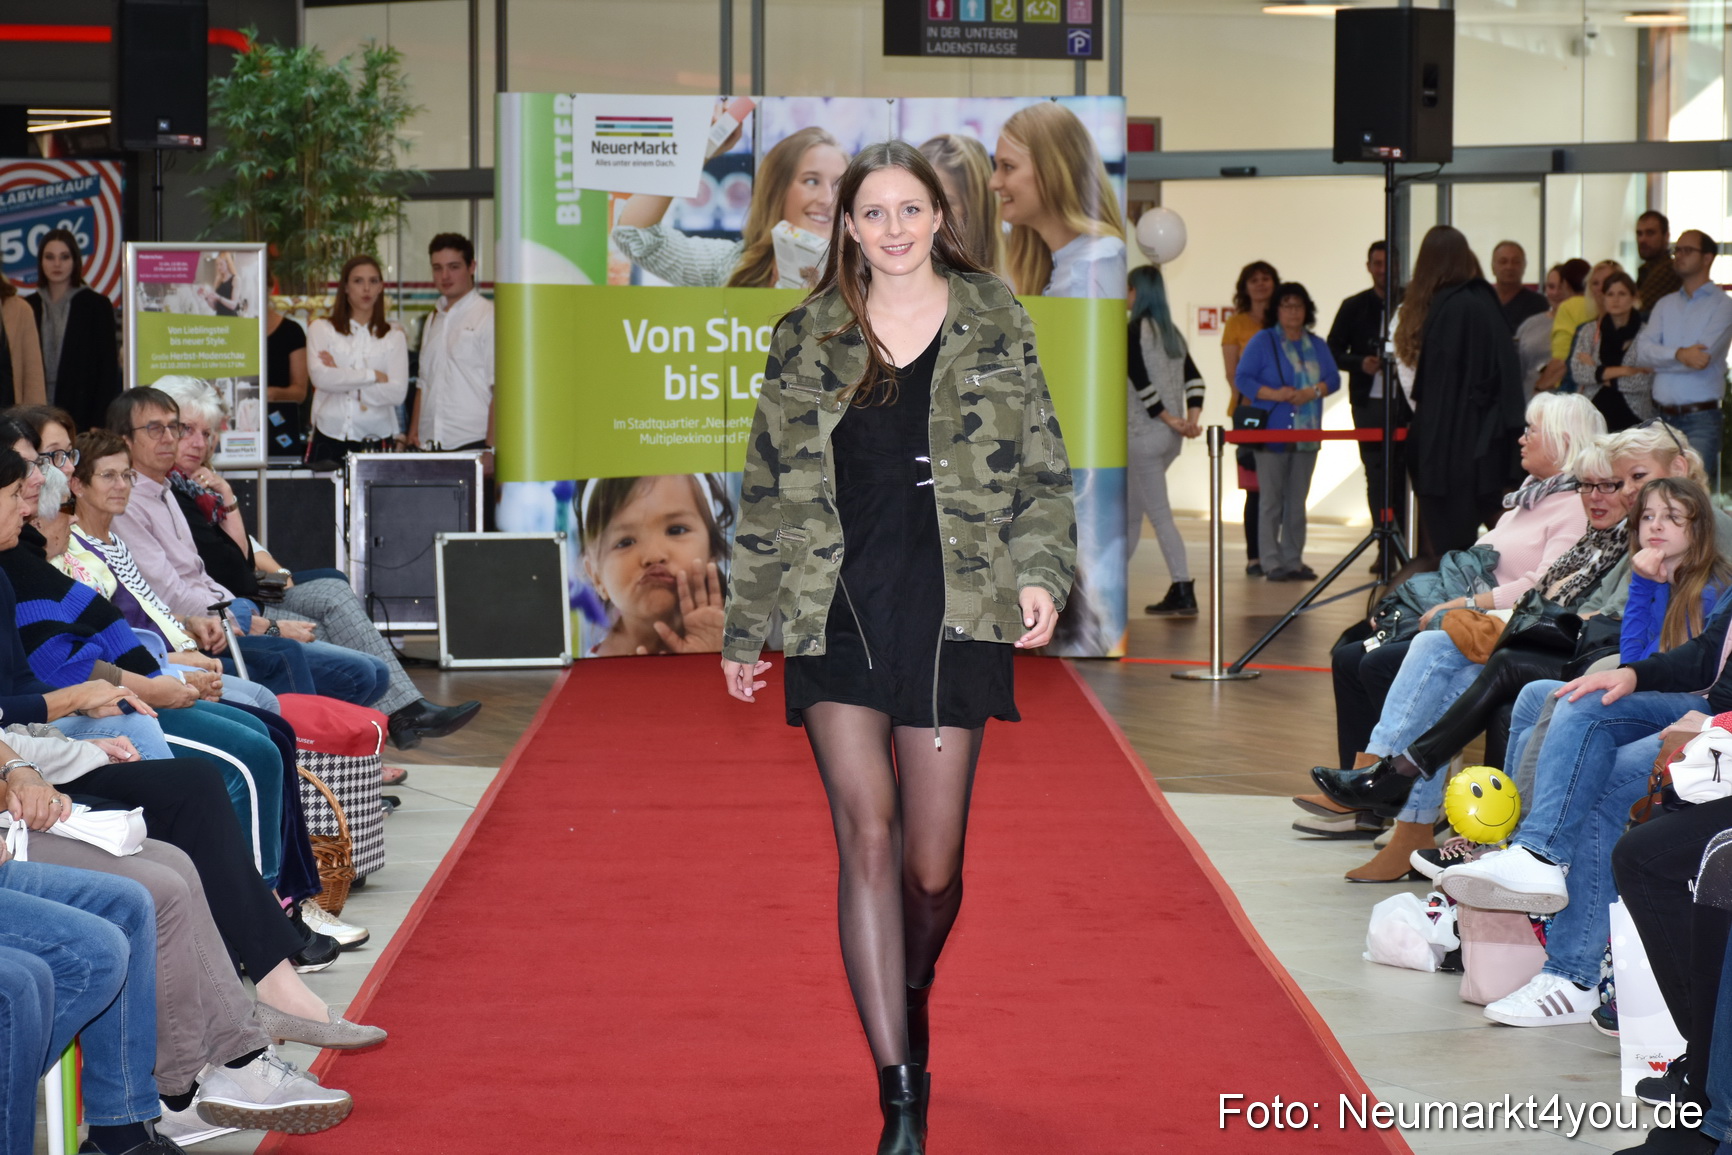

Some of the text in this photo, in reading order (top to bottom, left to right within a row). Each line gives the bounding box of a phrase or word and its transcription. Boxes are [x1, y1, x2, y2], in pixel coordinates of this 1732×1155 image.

[926, 27, 1018, 39] IN DER UNTEREN
[926, 42, 1017, 55] LADENSTRASSE
[591, 140, 678, 155] NeuerMarkt
[184, 326, 230, 336] Lieblingsteil
[622, 317, 774, 353] Von Sho
[665, 365, 764, 400] bis Le
[614, 417, 752, 430] Im Stadtquartier „NeuerMa
[640, 433, 712, 446] Multiplexkino
[714, 432, 736, 444] und
